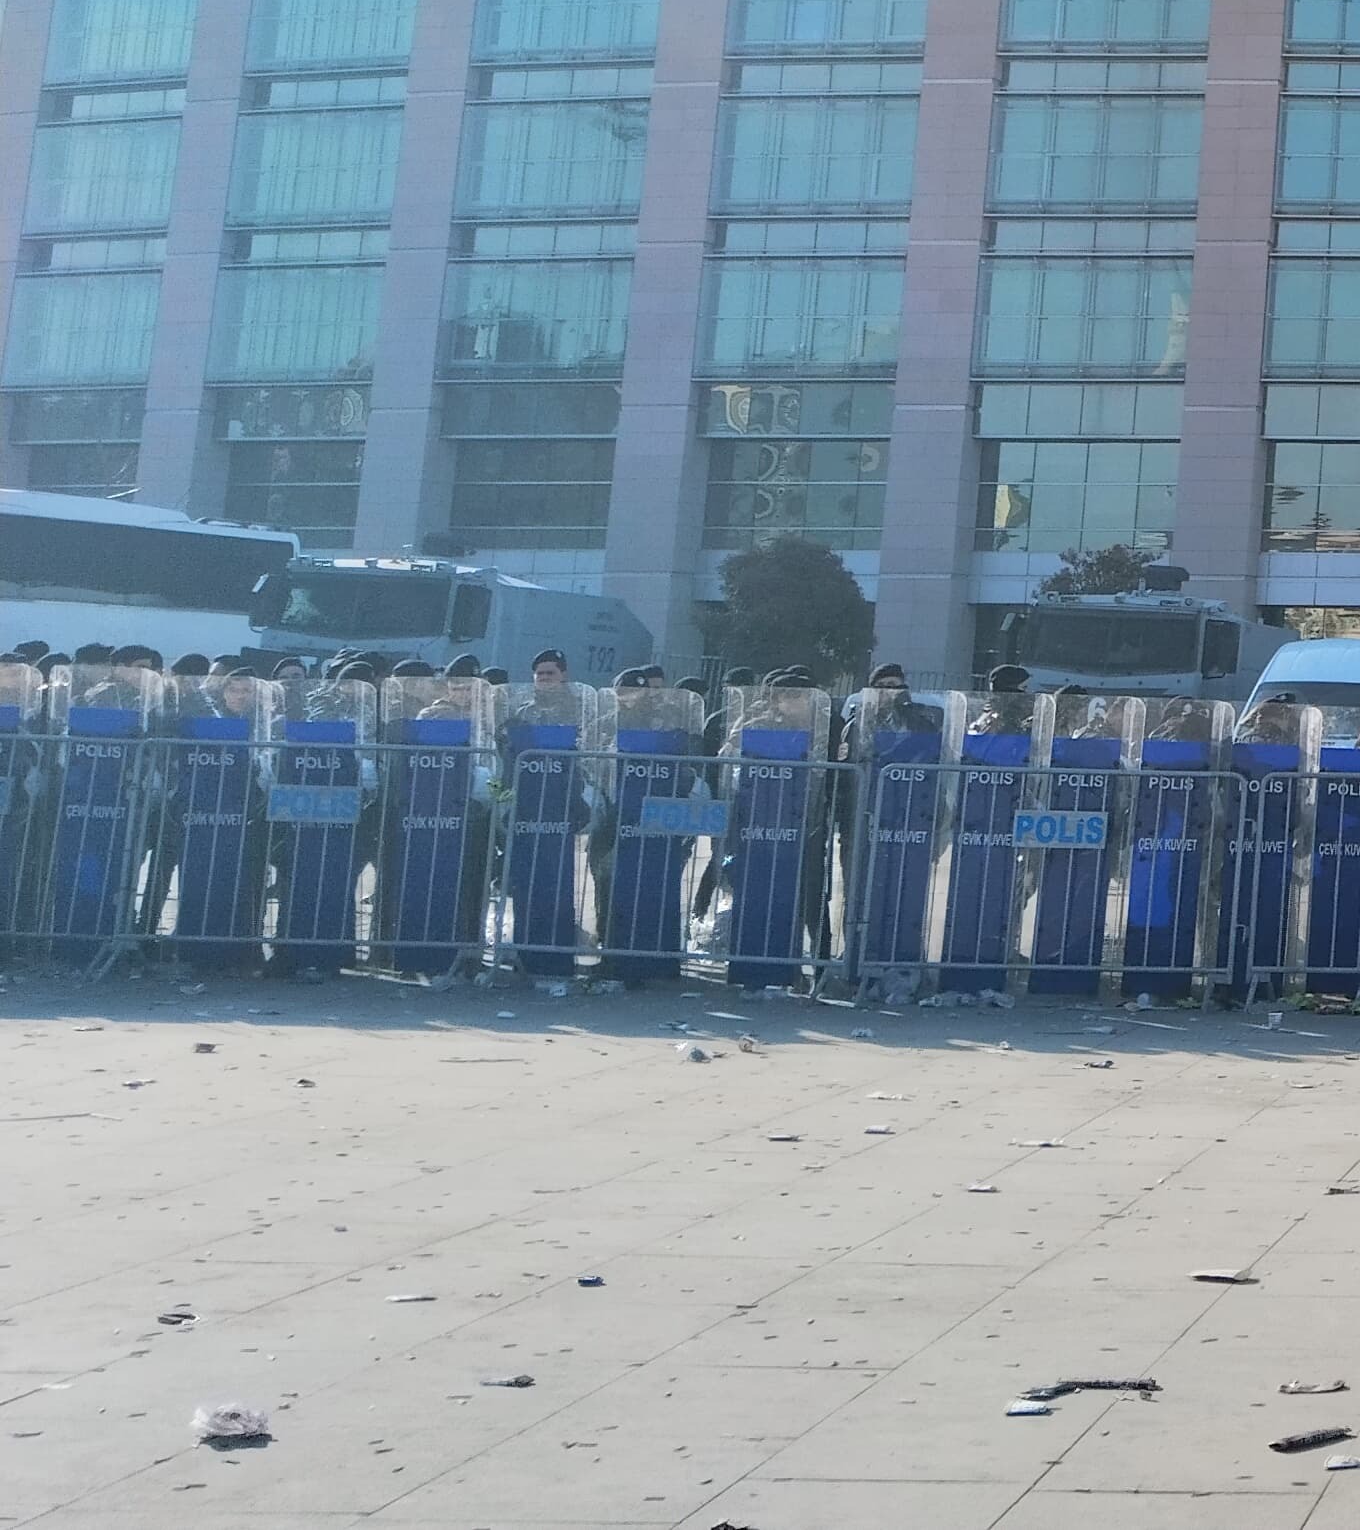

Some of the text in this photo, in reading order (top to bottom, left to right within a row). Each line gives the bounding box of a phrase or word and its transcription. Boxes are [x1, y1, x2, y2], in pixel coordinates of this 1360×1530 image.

[1016, 815, 1105, 844] POLİS
[1229, 838, 1286, 855] ÇVİK UVVET
